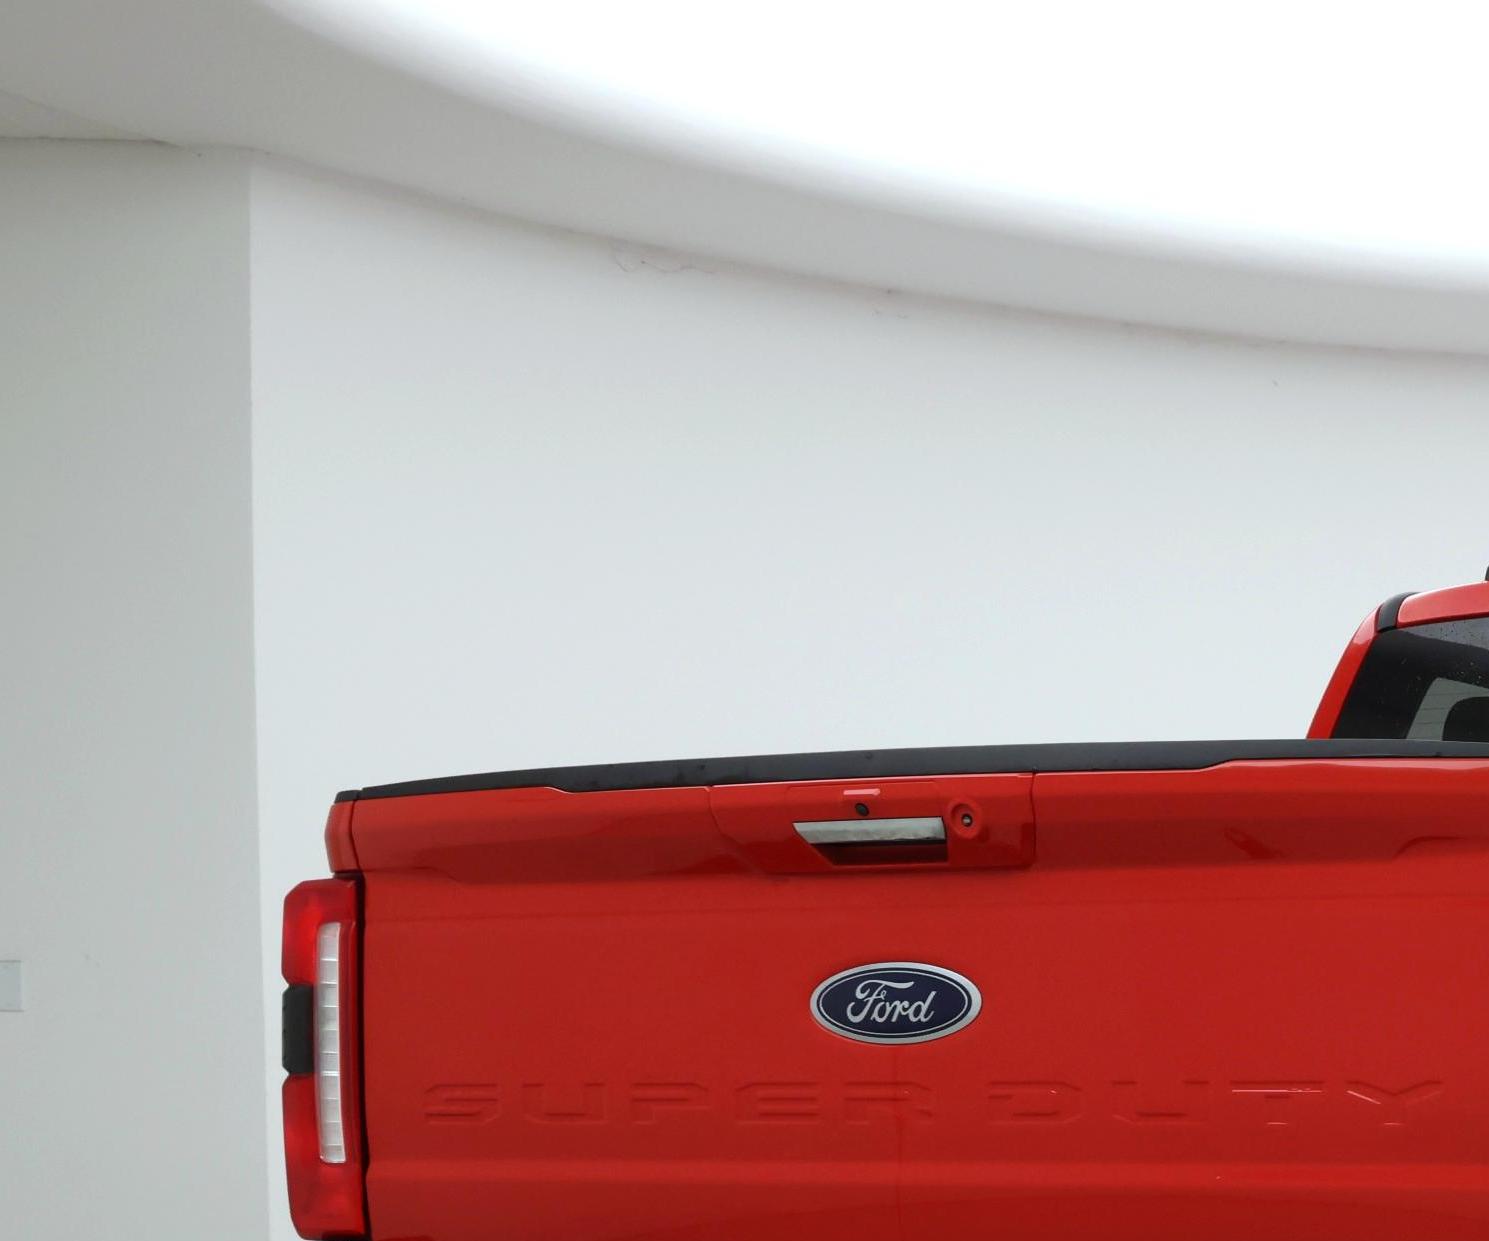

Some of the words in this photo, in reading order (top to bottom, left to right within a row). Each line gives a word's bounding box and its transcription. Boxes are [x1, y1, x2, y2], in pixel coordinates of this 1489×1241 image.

[846, 978, 937, 1024] Ford
[424, 1081, 936, 1126] SUPER
[988, 1079, 1443, 1126] DUTY
